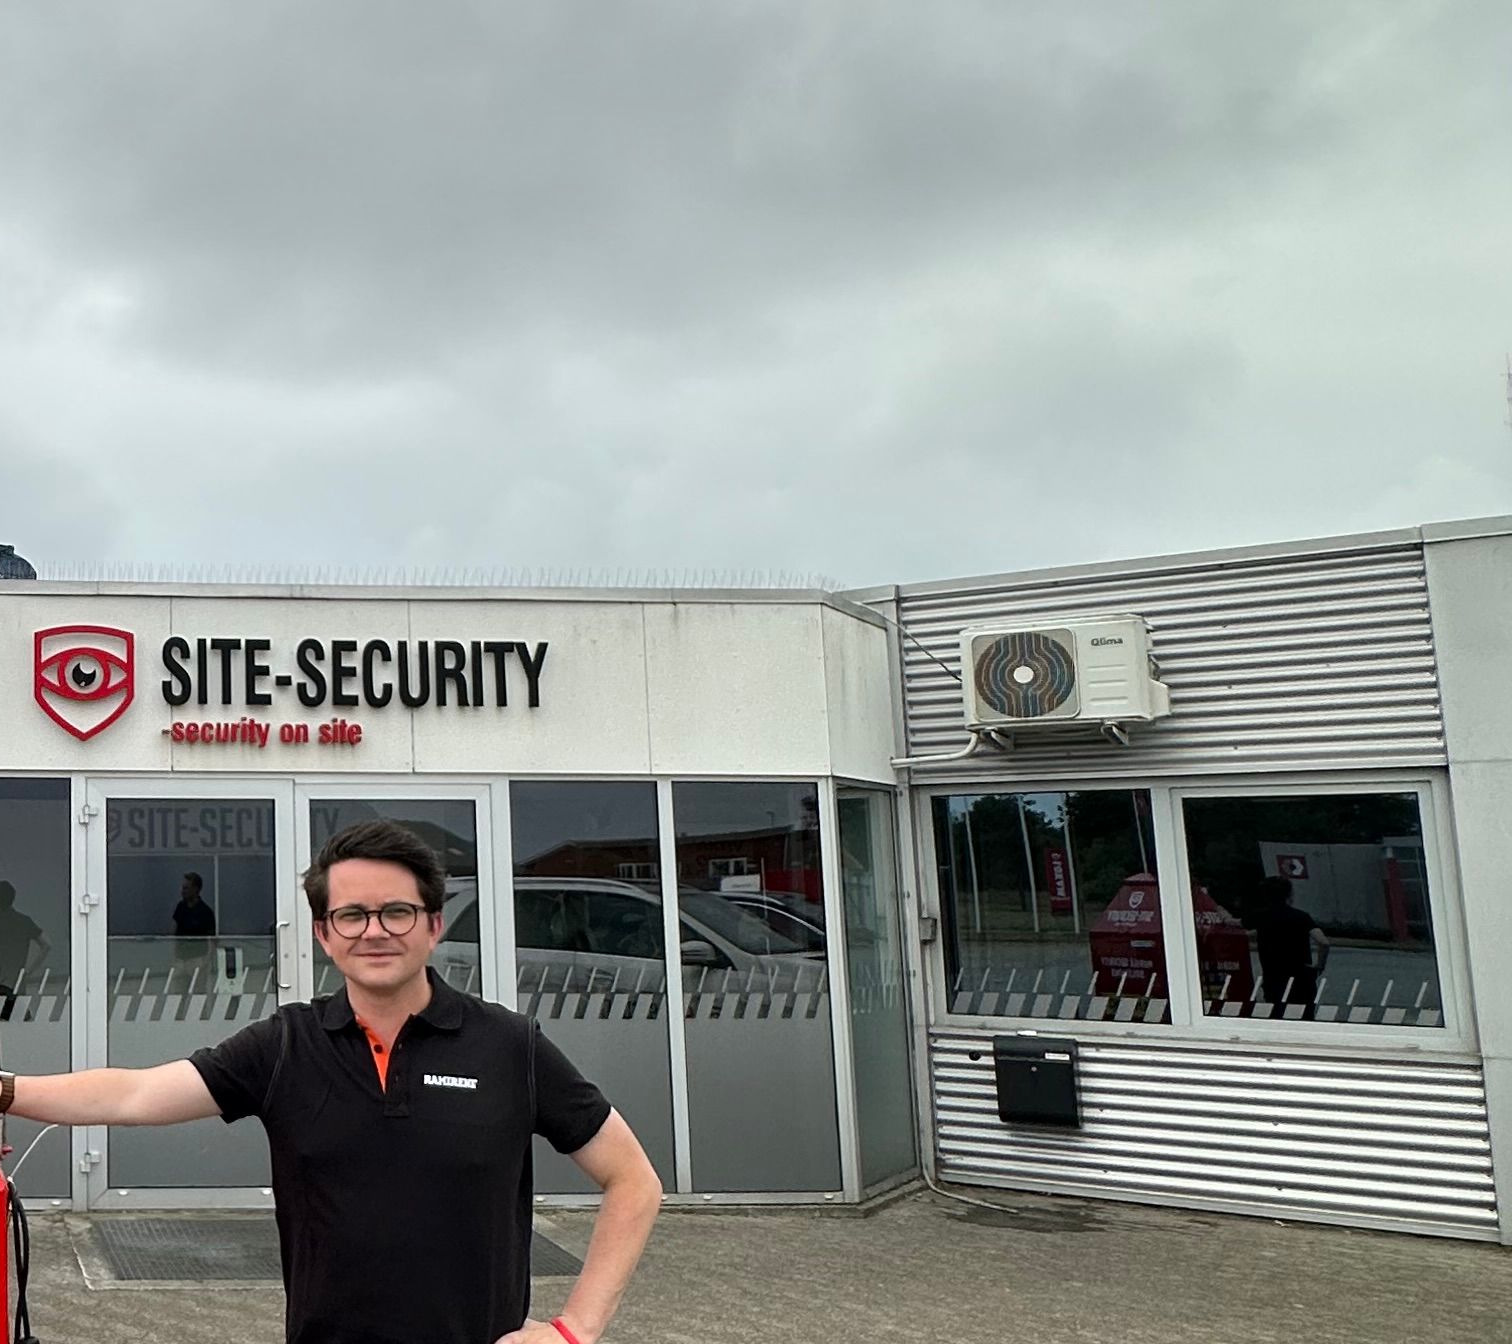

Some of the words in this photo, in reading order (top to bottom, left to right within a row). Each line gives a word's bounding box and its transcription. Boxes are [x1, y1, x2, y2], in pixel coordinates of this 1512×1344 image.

[1090, 637, 1124, 647] Qlima
[161, 636, 548, 708] SITE-SECURITY
[279, 722, 310, 744] on
[317, 717, 363, 746] site
[127, 806, 341, 849] SITE-SECUTY
